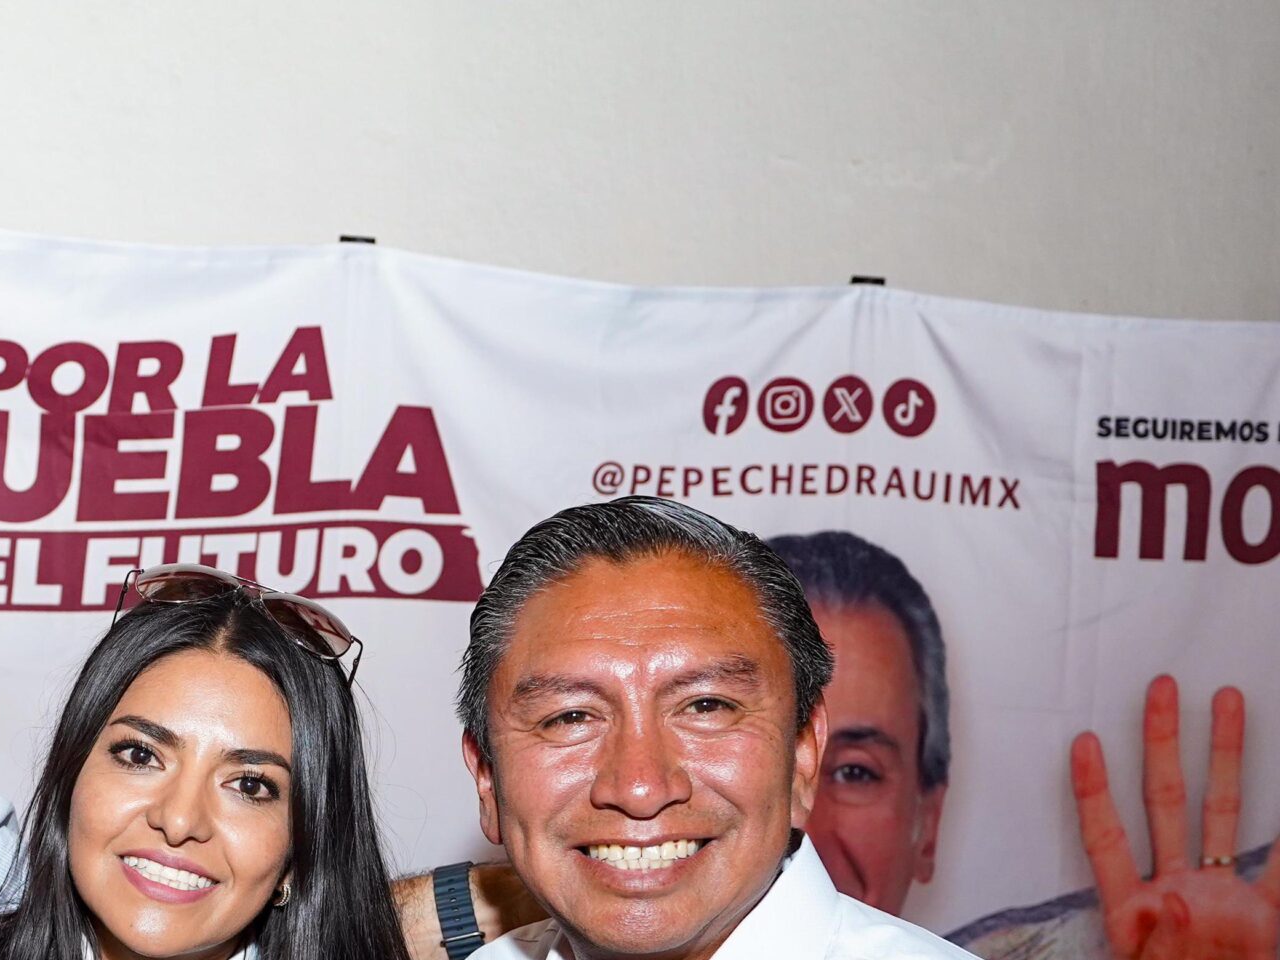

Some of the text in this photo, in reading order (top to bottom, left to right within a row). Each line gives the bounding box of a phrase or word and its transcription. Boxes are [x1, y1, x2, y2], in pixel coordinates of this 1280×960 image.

[202, 325, 334, 408] LA
[1097, 416, 1270, 443] SEGUIREMOS
[592, 460, 1022, 510] @PEPECHEDRAUIMX
